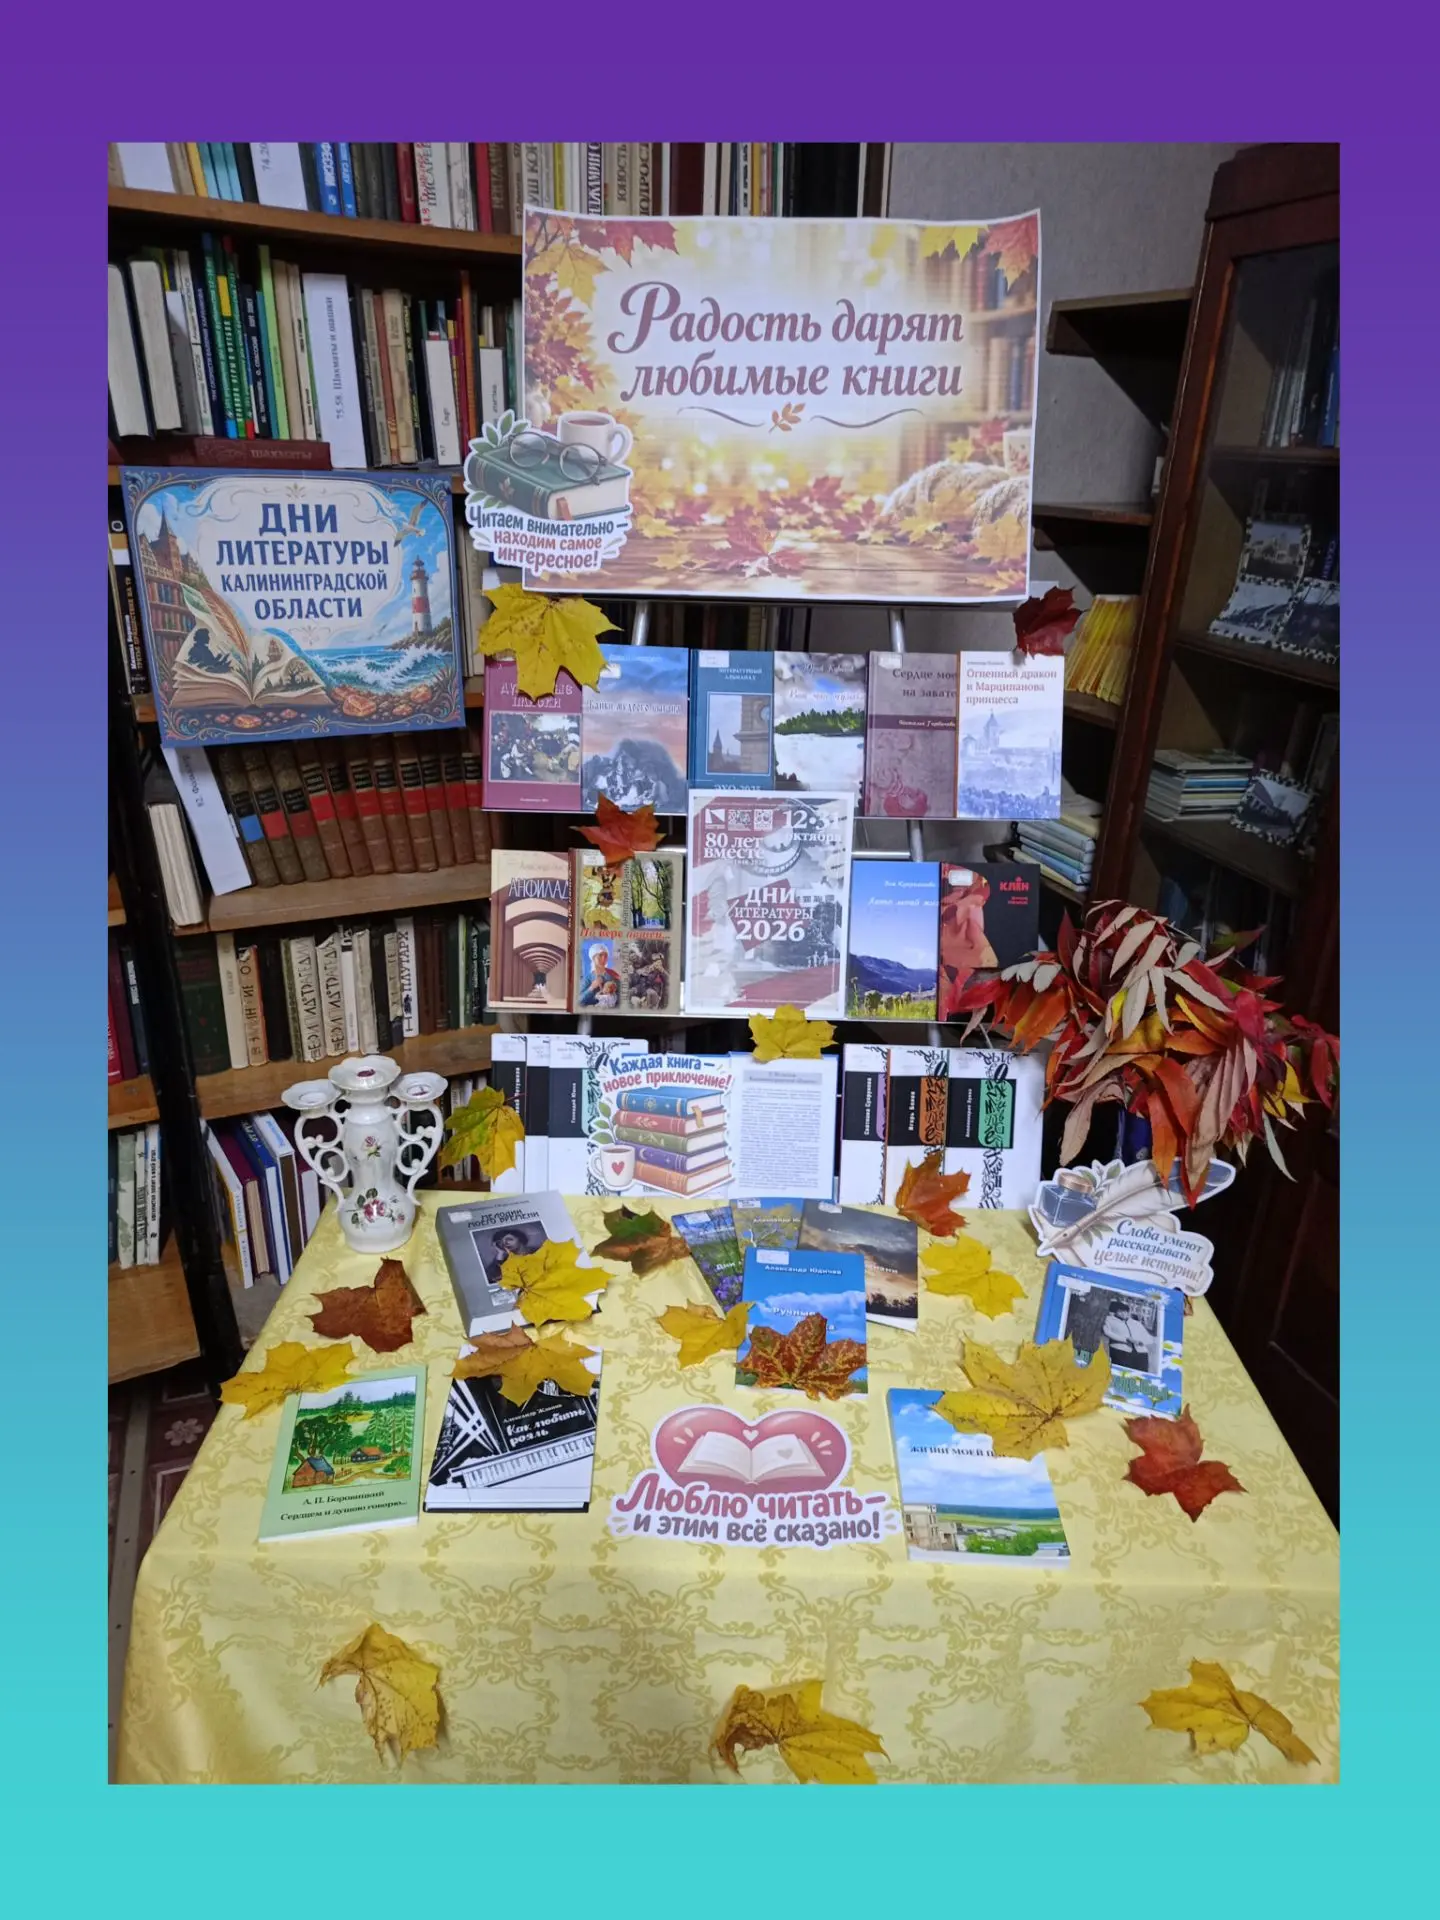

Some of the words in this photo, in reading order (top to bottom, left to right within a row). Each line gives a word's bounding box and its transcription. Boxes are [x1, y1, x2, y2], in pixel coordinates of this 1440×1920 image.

[616, 144, 627, 202] ЮНОСТЬ
[607, 281, 822, 354] Радость
[831, 298, 965, 355] дарят
[329, 342, 343, 390] Шахматы
[620, 349, 829, 402] любимые
[842, 365, 963, 397] книги
[259, 503, 338, 536] ДНИ
[470, 505, 524, 530] Читаем
[527, 518, 614, 537] внимательно
[494, 530, 556, 550] находим
[559, 537, 602, 551] самое
[216, 540, 390, 566] ЛИТЕРАТУРЫ
[497, 547, 599, 573] интересное!
[220, 569, 388, 593] КАЛИНИНГРАДСКОЙ
[254, 597, 363, 621] ОБЛАСТИ
[892, 668, 933, 680] Сердце
[966, 668, 1018, 679] Огненный
[1021, 670, 1057, 681] дракон
[902, 689, 916, 697] на
[975, 682, 1045, 693] Марципанова
[966, 696, 1019, 706] принцесса
[705, 832, 728, 848] 80
[731, 837, 764, 848] лет
[703, 848, 765, 859] вместе
[745, 887, 796, 907] ДНИ
[736, 920, 806, 942] 2026
[397, 931, 412, 992] ПЛУТАРХ
[609, 1056, 662, 1075] Каждая
[667, 1057, 702, 1070] книга
[603, 1073, 642, 1092] новое
[646, 1071, 732, 1090] приключение!
[908, 1091, 916, 1111] Белов
[864, 1109, 872, 1136] Светлана
[908, 1112, 916, 1131] Игорь
[468, 1217, 497, 1228] МОЕГО
[500, 1211, 540, 1223] ВРЕМЕНИ
[1117, 1219, 1160, 1241] Слова
[1160, 1235, 1203, 1254] умеют
[1107, 1237, 1192, 1262] рассказывать
[765, 1264, 807, 1273] Александр
[1094, 1249, 1138, 1266] целые
[1141, 1256, 1204, 1283] истории!
[503, 1410, 537, 1423] Александр
[507, 1424, 532, 1437] Как
[534, 1409, 586, 1428] любить
[510, 1429, 550, 1447] рояль
[616, 1473, 748, 1518] Люблю
[280, 1511, 323, 1521] Сердцем
[332, 1506, 366, 1515] душою
[633, 1514, 651, 1533] и
[657, 1515, 719, 1538] этим
[726, 1519, 768, 1542] всё
[774, 1511, 881, 1547] сказано!
